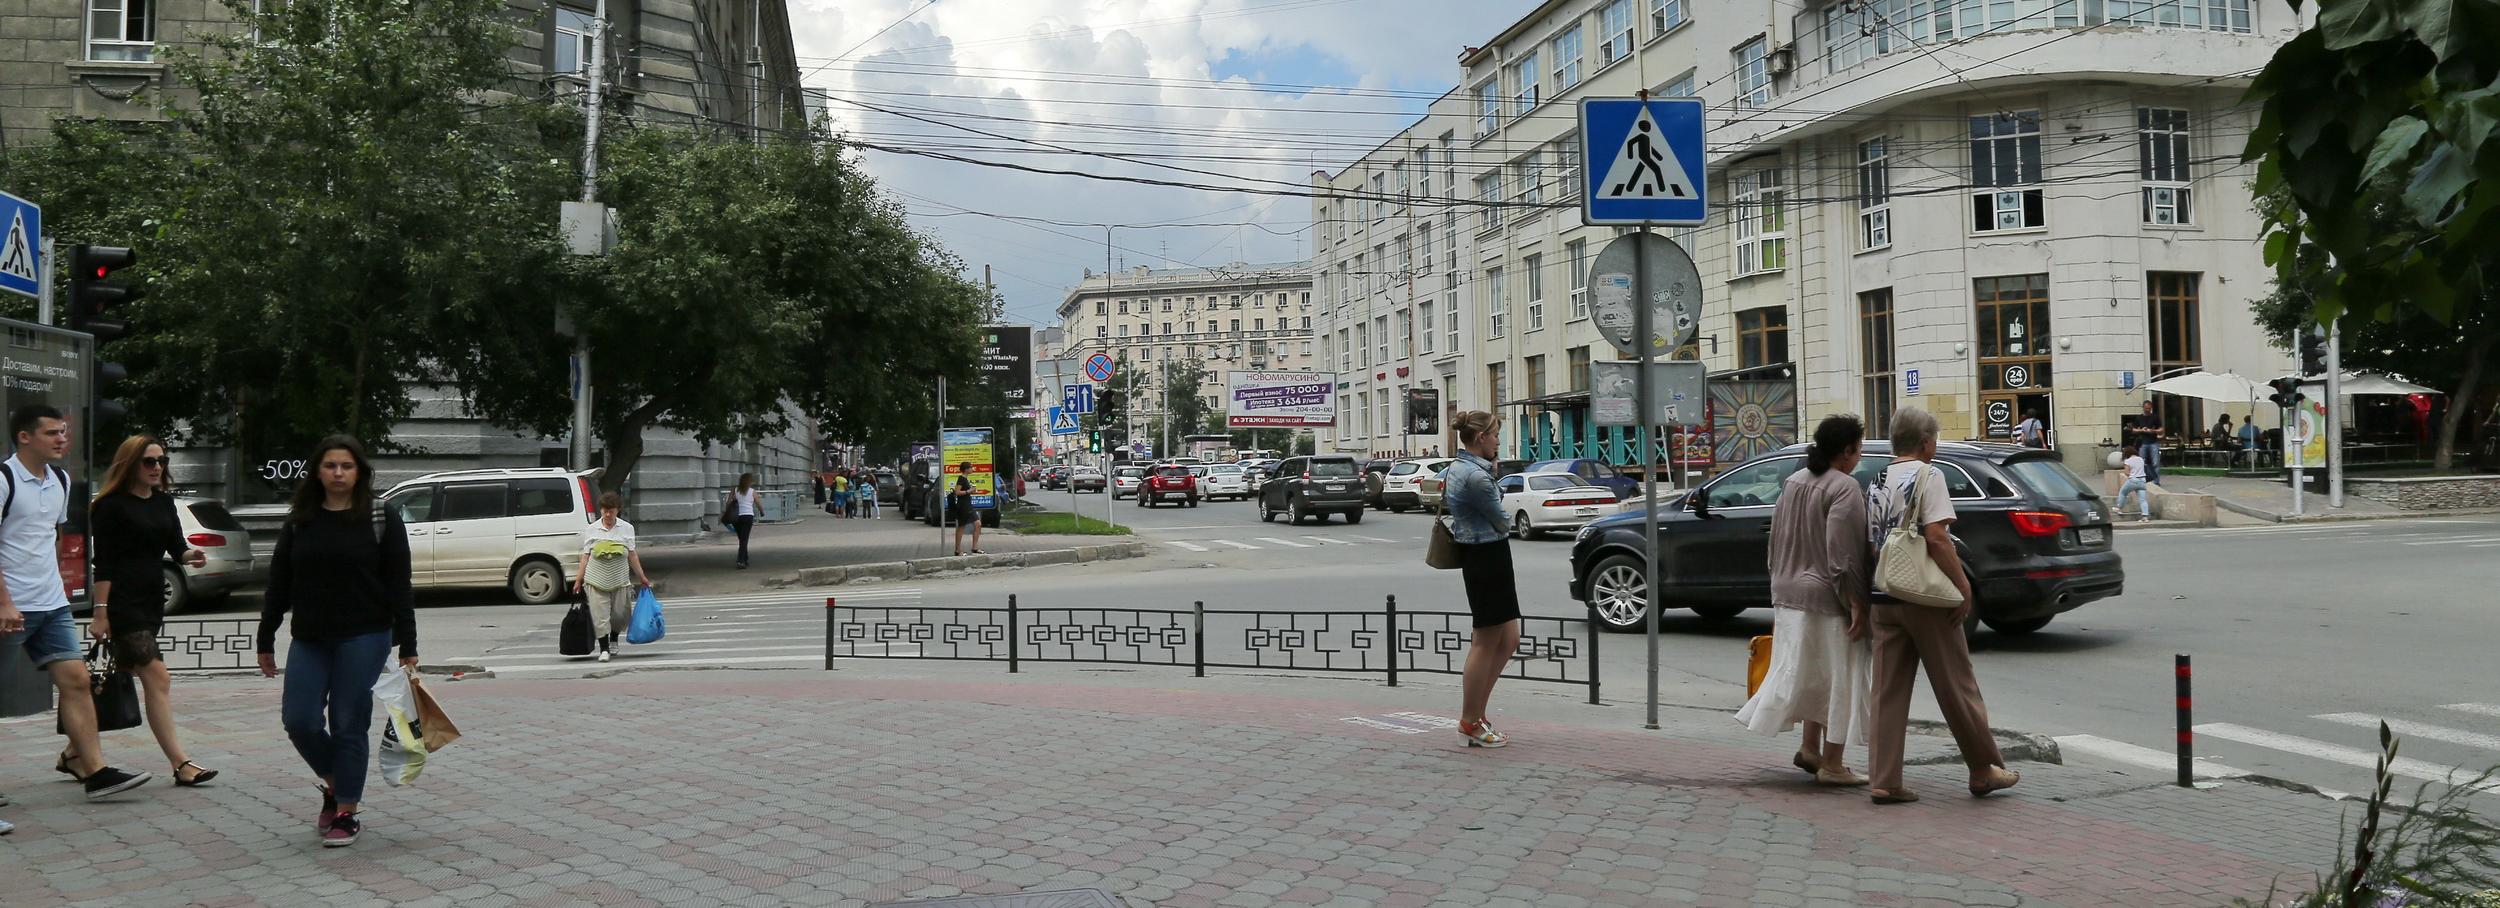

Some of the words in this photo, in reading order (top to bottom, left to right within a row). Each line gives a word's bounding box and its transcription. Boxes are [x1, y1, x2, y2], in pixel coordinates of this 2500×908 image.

[2, 356, 42, 374] Доставим,
[1246, 373, 1320, 382] НОВОМАРУСИНО
[1908, 372, 1917, 385] 18
[2010, 370, 2022, 378] 24
[2, 375, 18, 388] 10%
[1240, 390, 1264, 398] Первый
[1285, 386, 1296, 395] 75
[1298, 385, 1319, 394] 000
[1277, 398, 1283, 406] 3
[1285, 397, 1301, 406] 634
[1094, 431, 1099, 440] 6
[257, 459, 309, 479] -50%
